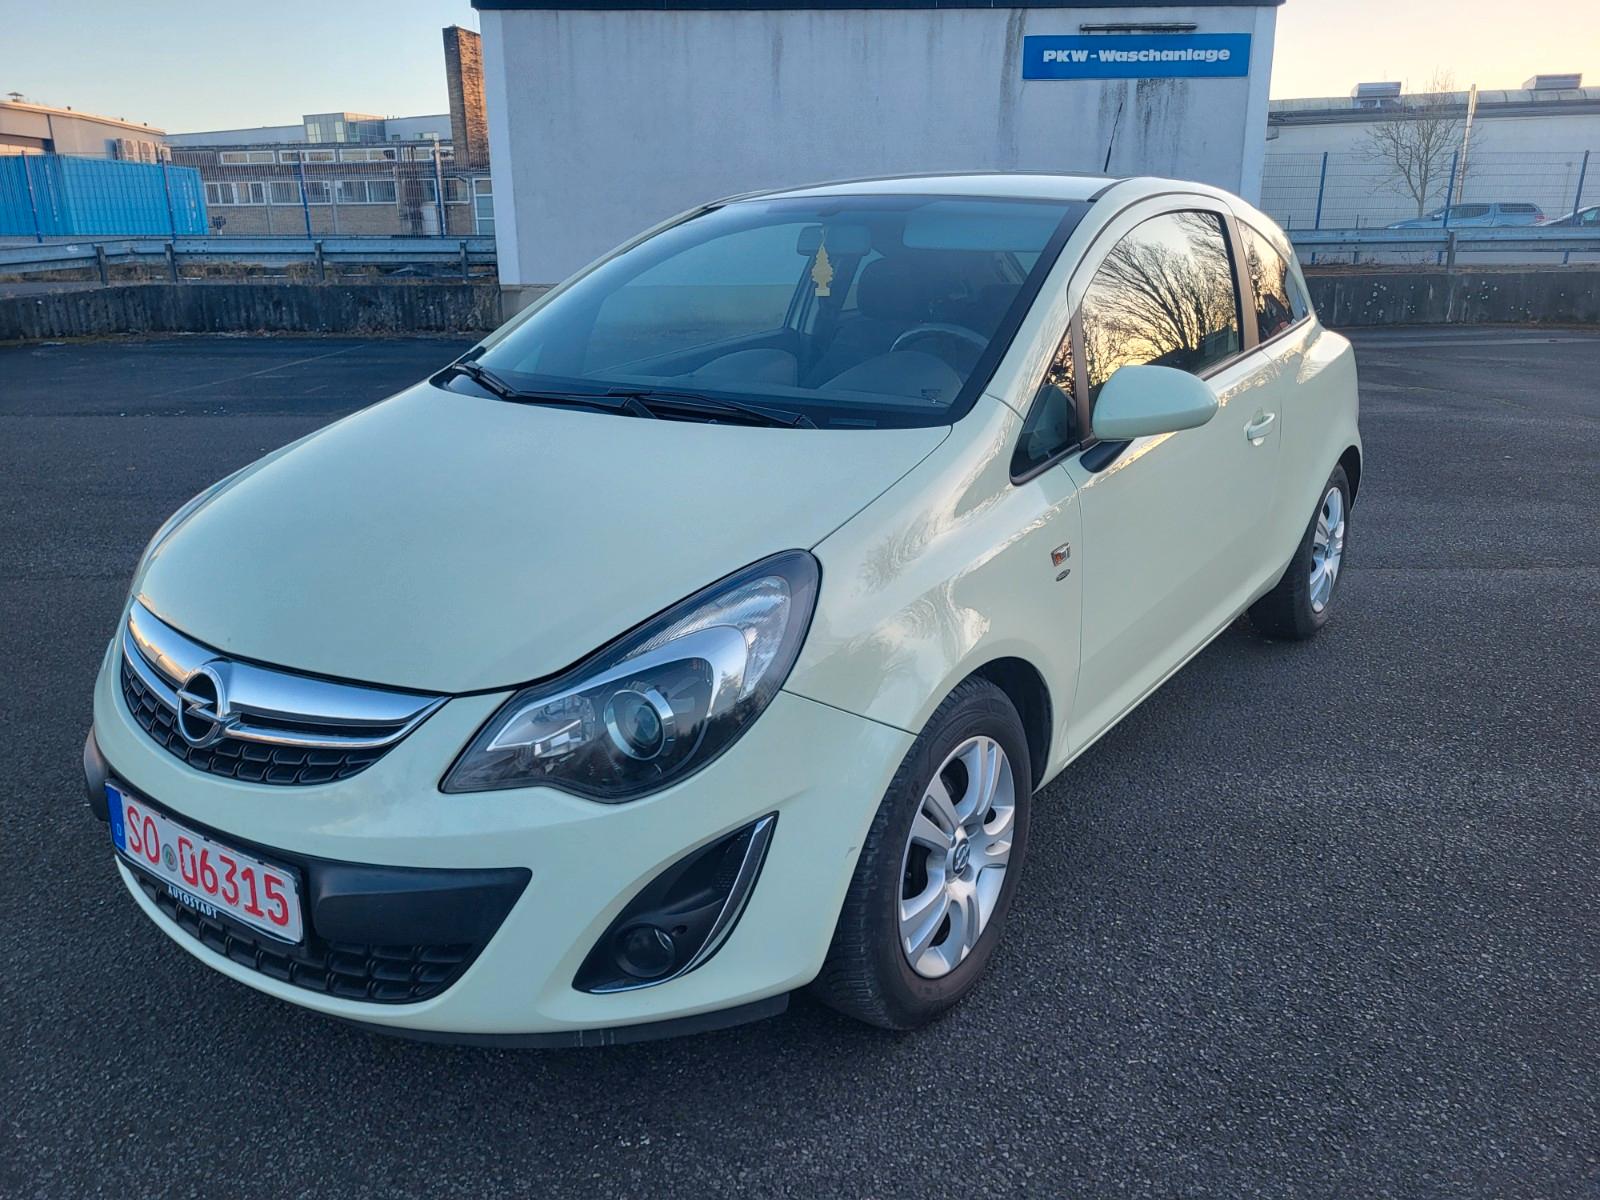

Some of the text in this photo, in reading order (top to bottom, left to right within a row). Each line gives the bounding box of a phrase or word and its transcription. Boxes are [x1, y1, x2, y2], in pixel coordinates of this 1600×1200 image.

[127, 806, 289, 927] SO 06315
[168, 885, 218, 919] AUTOSTADT
